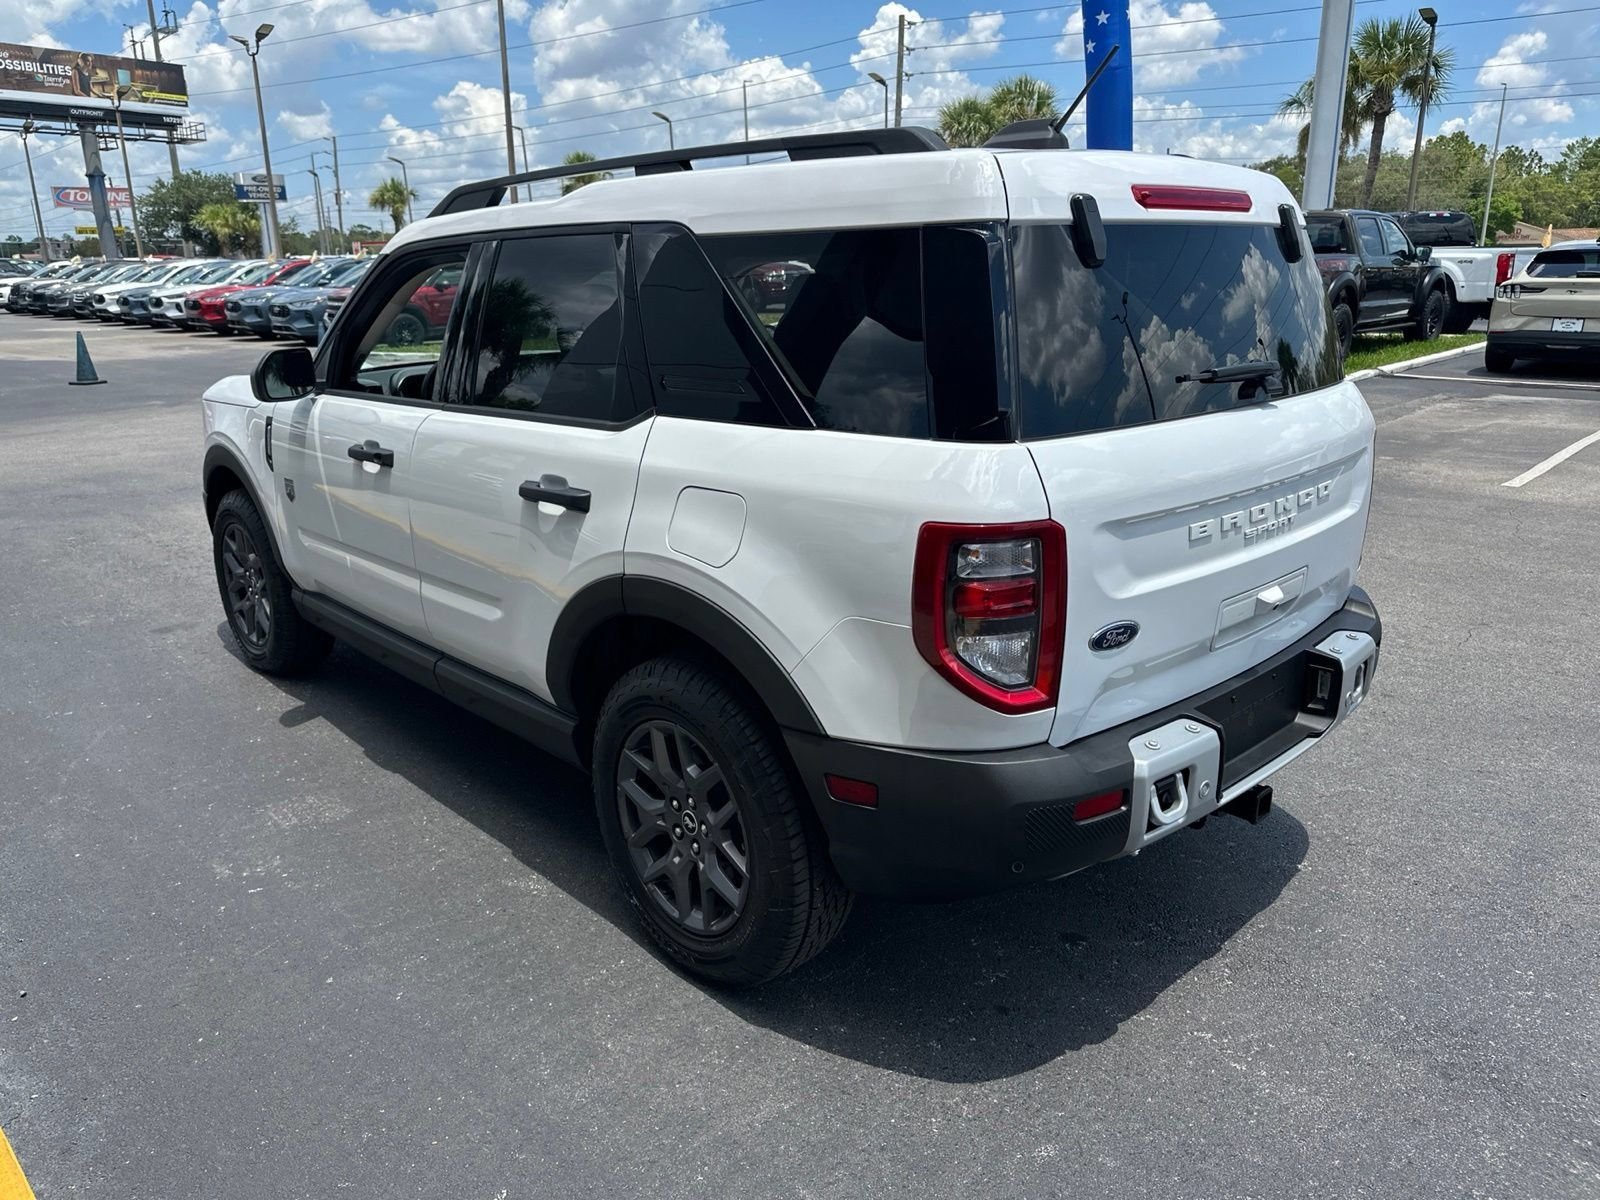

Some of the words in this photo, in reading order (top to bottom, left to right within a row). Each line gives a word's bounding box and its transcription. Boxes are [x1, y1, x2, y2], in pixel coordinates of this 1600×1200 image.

[1189, 479, 1333, 541] BRONCO
[1244, 513, 1297, 539] SPORT
[1102, 628, 1131, 648] Ford
